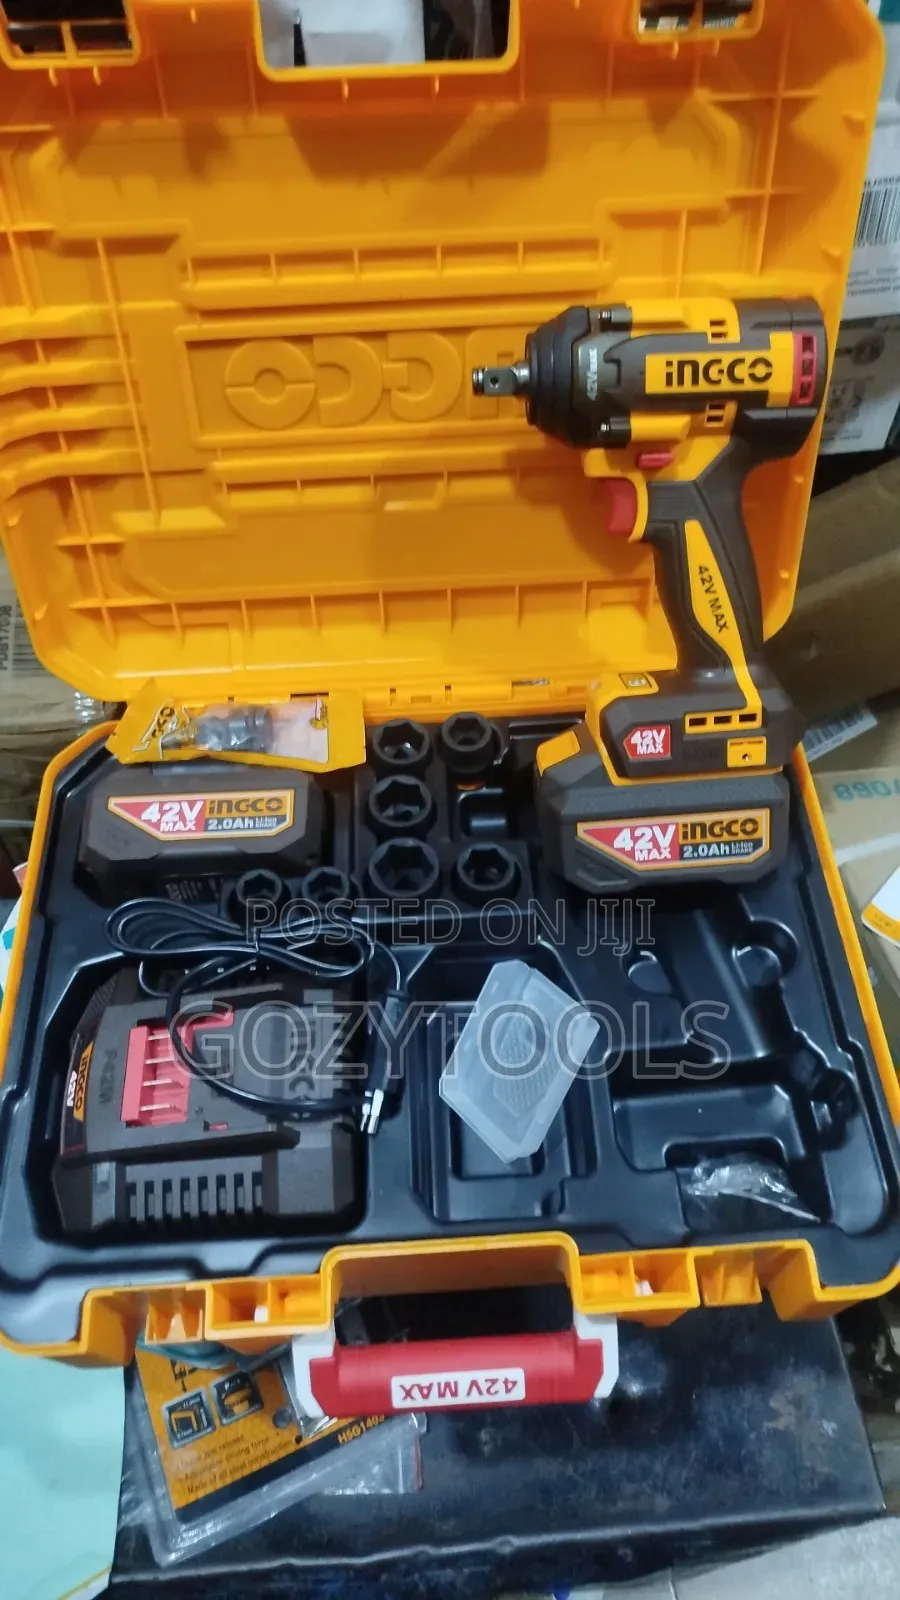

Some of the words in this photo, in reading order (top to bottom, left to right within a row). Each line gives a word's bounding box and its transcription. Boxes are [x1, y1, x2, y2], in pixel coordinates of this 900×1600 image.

[698, 565, 716, 595] 42V
[709, 597, 729, 634] MAX
[631, 728, 665, 745] 42V
[637, 742, 664, 755] MAX
[140, 800, 204, 823] 42V
[160, 820, 196, 832] MAX
[207, 817, 254, 831] 2.0Ah
[613, 824, 676, 851] 42V
[635, 848, 671, 862] MAX
[683, 844, 730, 859] 2.0Ah
[66, 1070, 78, 1107] 42V
[400, 1380, 458, 1400] MAX
[466, 1377, 518, 1396] 42V
